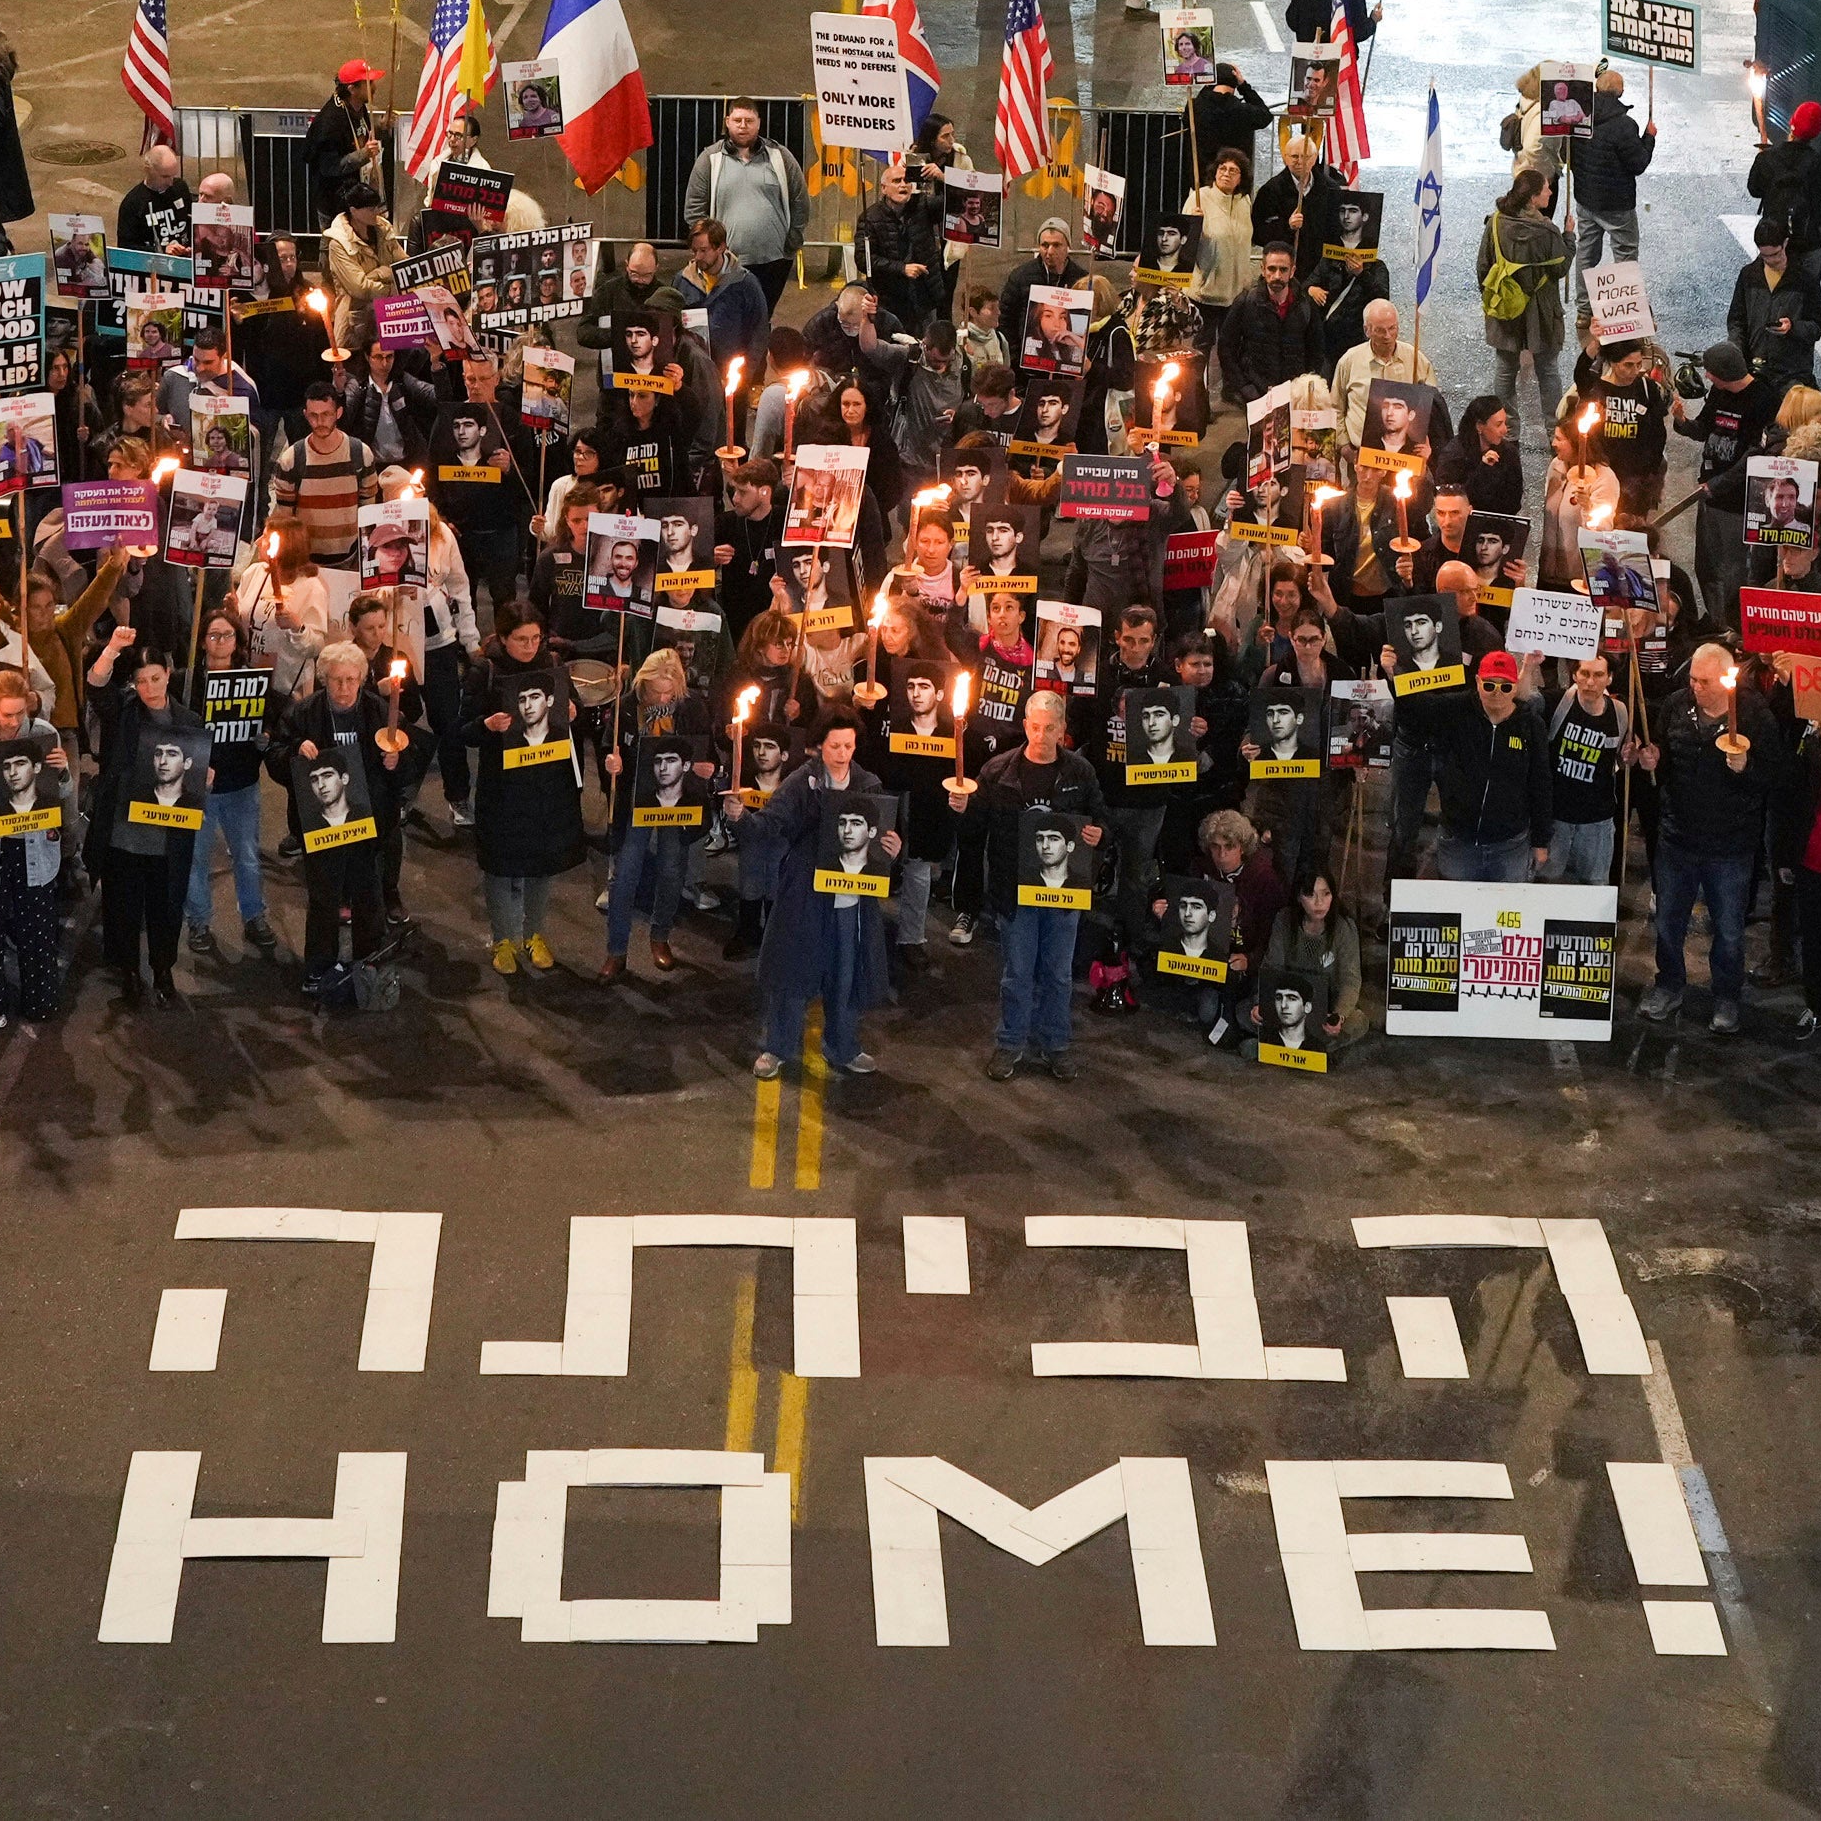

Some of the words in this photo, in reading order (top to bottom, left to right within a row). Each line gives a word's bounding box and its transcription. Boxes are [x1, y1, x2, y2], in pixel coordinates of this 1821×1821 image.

[1643, 2, 1693, 28] עצרו
[815, 31, 830, 41] THE
[833, 34, 866, 44] DEMAND
[869, 36, 885, 46] FOR
[887, 39, 894, 47] A
[1609, 18, 1693, 47] המלחמה
[815, 45, 840, 55] SINGLE
[842, 47, 874, 57] HOSTAGE
[876, 50, 895, 59] DEAL
[815, 57, 841, 68] NEEDS
[844, 60, 857, 69] NO
[860, 62, 897, 73] DEFENSE
[821, 91, 855, 105] ONLY
[858, 95, 895, 109] MORE
[825, 113, 896, 131] DEFENDERS
[450, 172, 478, 185] שבויים
[481, 180, 501, 189] פדיון
[1597, 273, 1616, 288] NO
[1597, 285, 1639, 301] MORE
[1602, 302, 1639, 318] WAR
[12, 342, 38, 363] BE
[1606, 396, 1620, 410] GET
[1622, 398, 1636, 412] MY
[1606, 409, 1638, 424] PEOPLE
[1604, 422, 1638, 439] HOME!
[1076, 466, 1112, 478] שבויים
[1113, 468, 1138, 479] פדיון
[1534, 614, 1551, 625] לנו
[1746, 605, 1780, 620] חוזרים
[1781, 610, 1807, 622] שהם
[1808, 612, 1821, 623] עד
[1559, 618, 1597, 630] מחכים
[1514, 627, 1545, 641] כוחם
[1548, 632, 1595, 647] בשארית
[1409, 677, 1431, 689] כלפון
[1433, 673, 1451, 682] שגב
[978, 698, 1016, 722] בעזה?
[1564, 722, 1579, 740] הם
[905, 741, 920, 751] כהן
[1580, 729, 1606, 749] למה
[922, 742, 944, 752] נמרוד
[1559, 738, 1602, 764] עדיין
[1134, 771, 1177, 781] קופרשטיין
[1265, 766, 1282, 775] כהן
[1283, 765, 1304, 773] נמרוד
[1557, 756, 1596, 783] בעזה?
[142, 810, 170, 820] שרעבי
[172, 815, 188, 823] יוסי
[825, 877, 853, 889] קלדרון
[857, 881, 877, 890] עופר
[1035, 893, 1059, 902] שוהם
[1062, 893, 1073, 903] טל
[1404, 942, 1422, 958] הם
[1423, 942, 1458, 959] בשבי
[1501, 933, 1543, 958] כולם
[1167, 959, 1200, 973] צנגאוקר
[1394, 957, 1424, 974] מוות
[1425, 958, 1458, 975] סכנת
[1557, 951, 1575, 967] הם
[1577, 953, 1611, 968] בשבי
[1202, 965, 1218, 976] מתן
[1462, 957, 1542, 986] הומניטרי
[1545, 965, 1577, 981] מוות
[1579, 967, 1611, 983] סכנת
[1279, 1052, 1291, 1061] לוי
[1292, 1056, 1306, 1064] אור
[150, 1207, 1651, 1382] הביתה
[98, 1449, 1727, 1657] HOME!
